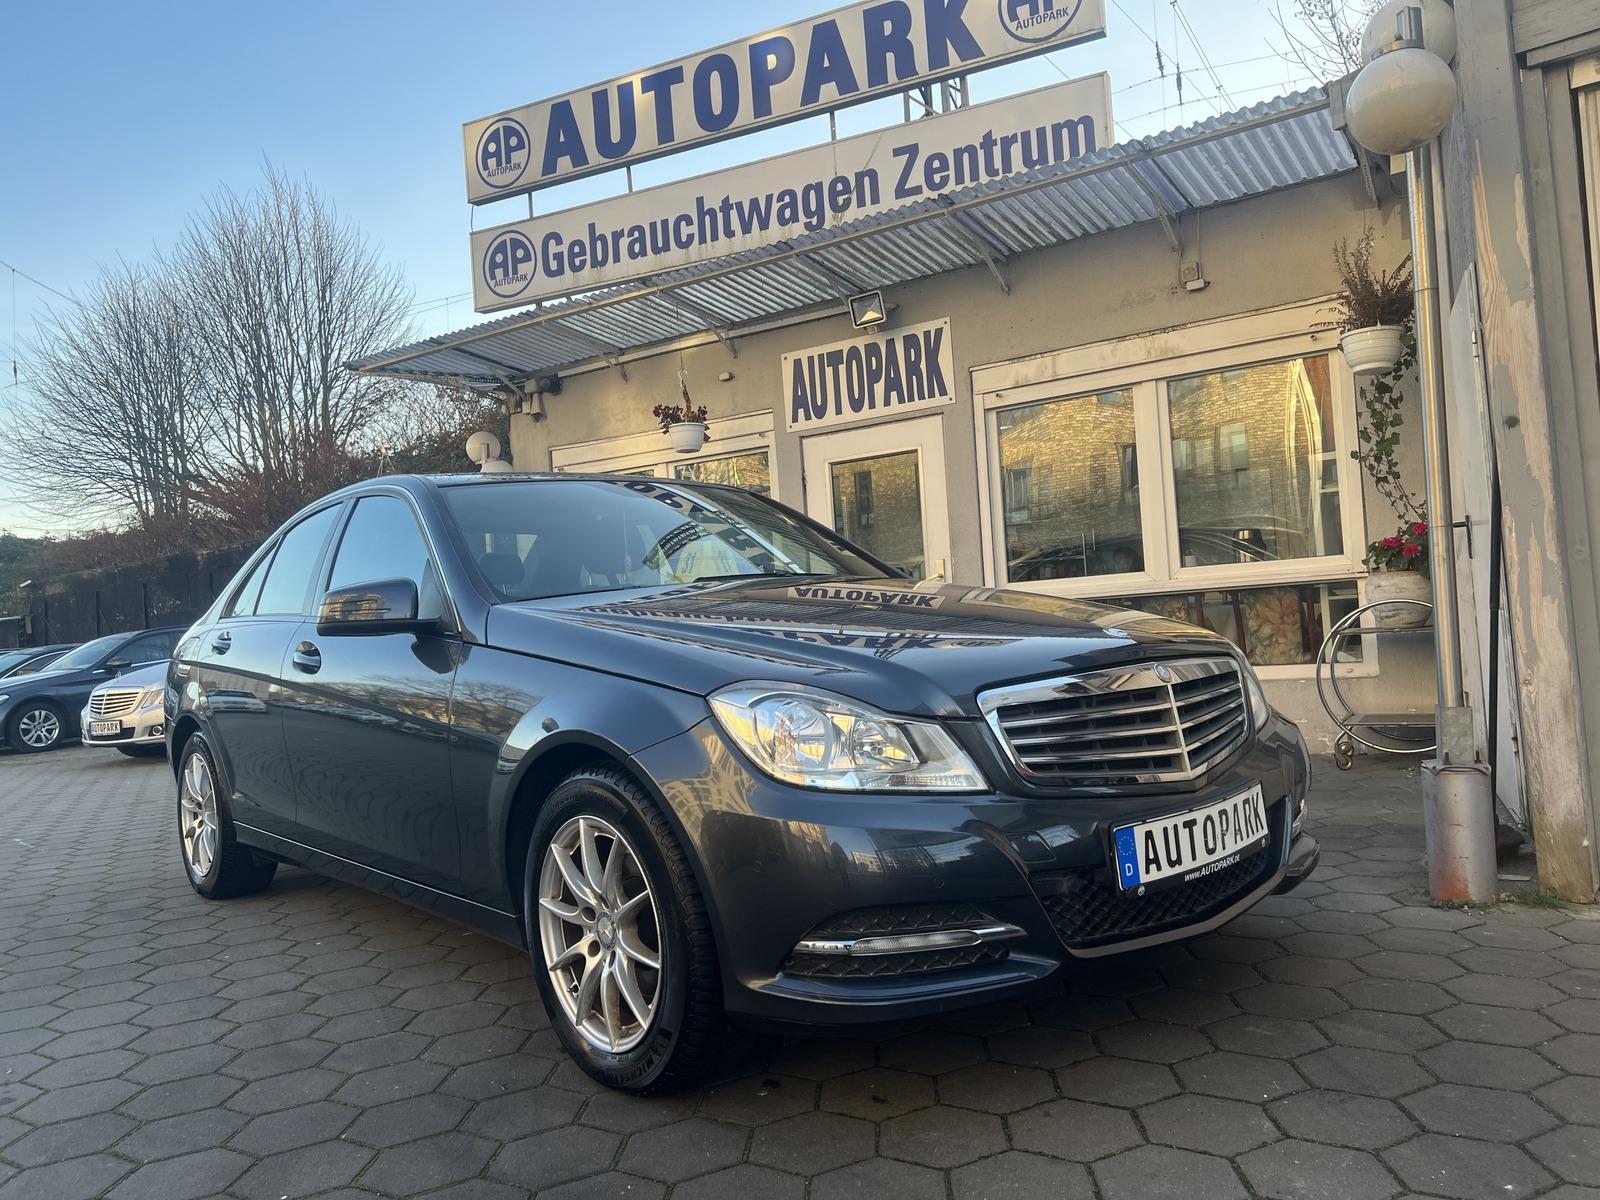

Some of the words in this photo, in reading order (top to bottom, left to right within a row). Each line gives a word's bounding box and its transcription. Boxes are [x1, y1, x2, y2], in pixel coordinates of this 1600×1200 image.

[1015, 6, 1069, 31] AUTOPARK
[541, 0, 985, 177] AUTOPARK
[481, 125, 526, 171] AP
[487, 162, 522, 178] AUTOPARK
[541, 168, 880, 278] Gebrauchtwagen
[892, 114, 1096, 199] Zentrum
[489, 237, 532, 281] AP
[494, 273, 529, 288] AUTOPARK
[791, 327, 948, 424] AUTOPARK
[1144, 791, 1264, 875] AUTOPARK
[1125, 863, 1133, 876] D
